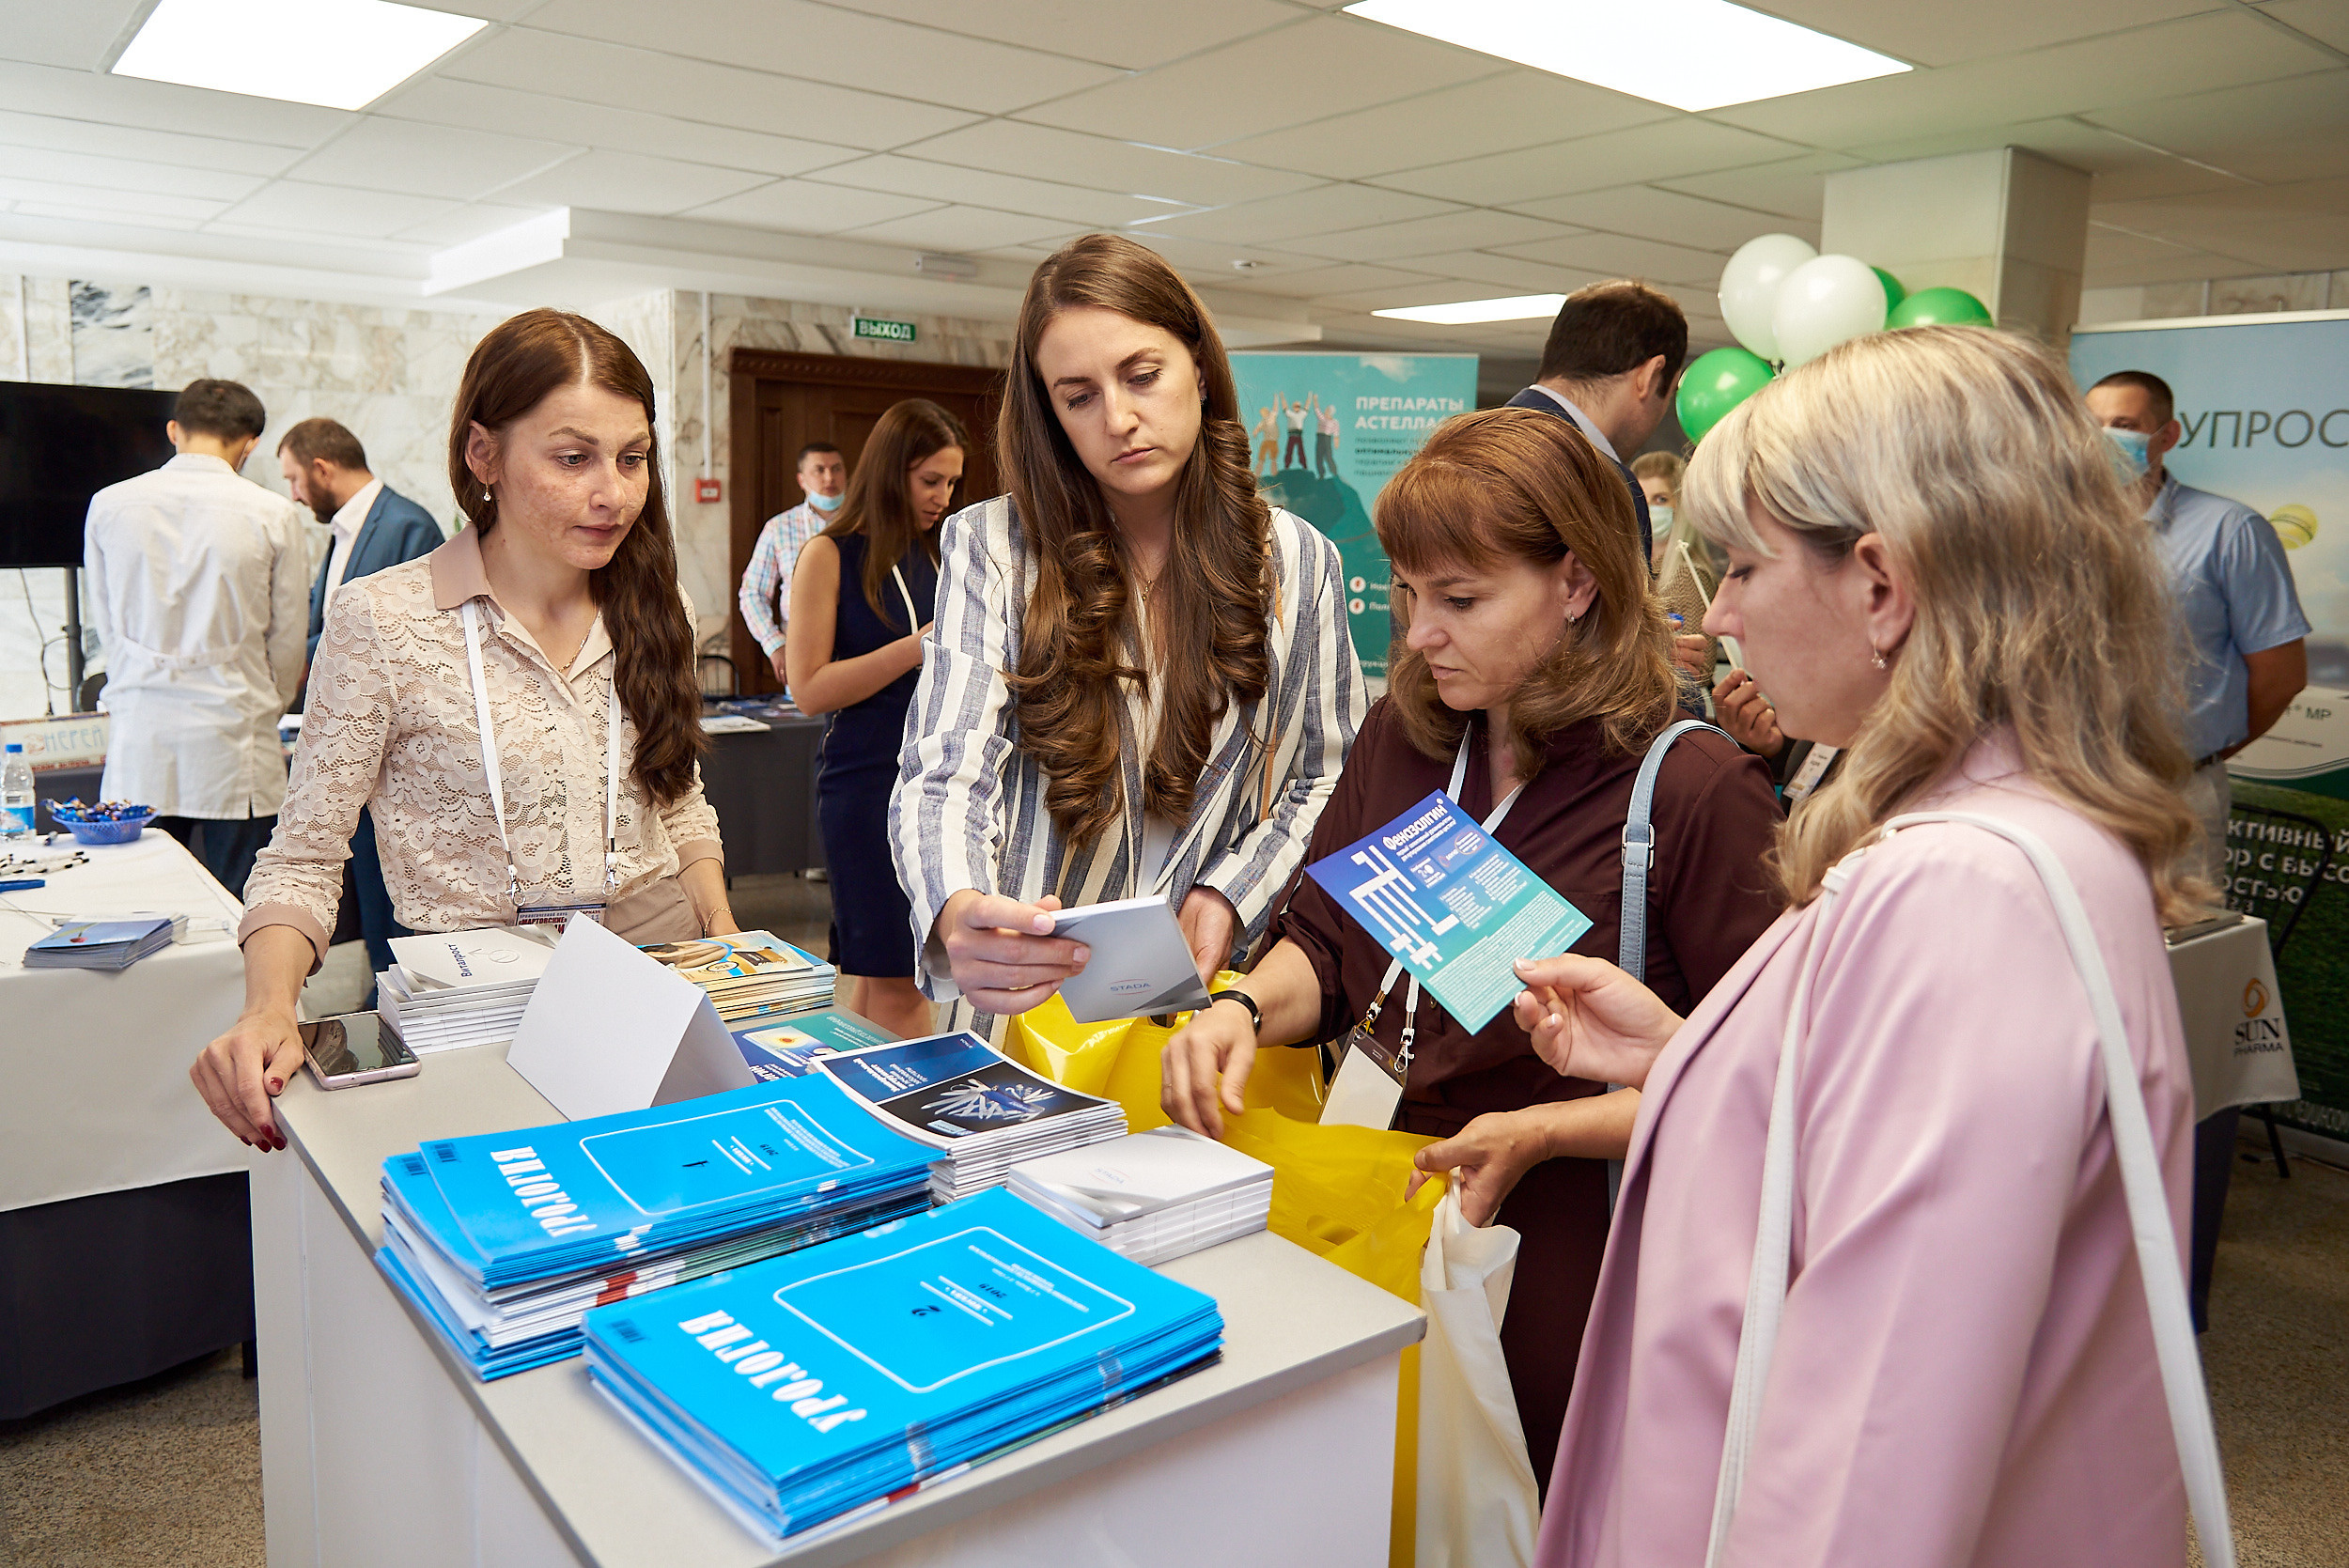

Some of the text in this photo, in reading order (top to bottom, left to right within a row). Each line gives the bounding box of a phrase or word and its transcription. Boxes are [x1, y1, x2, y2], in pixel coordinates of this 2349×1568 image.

[859, 320, 911, 338] ВЫХОД
[1356, 396, 1464, 411] ПРЕПАРАТЫ
[2179, 409, 2349, 448] УПРОС
[1110, 982, 1151, 992] STADA
[2234, 1017, 2281, 1046] SUN
[2233, 1042, 2284, 1059] PHARMA
[490, 1146, 598, 1237] УРОЛОГИЯ
[978, 1282, 1007, 1298] 2019
[677, 1310, 867, 1434] УРОЛОГИЯ
